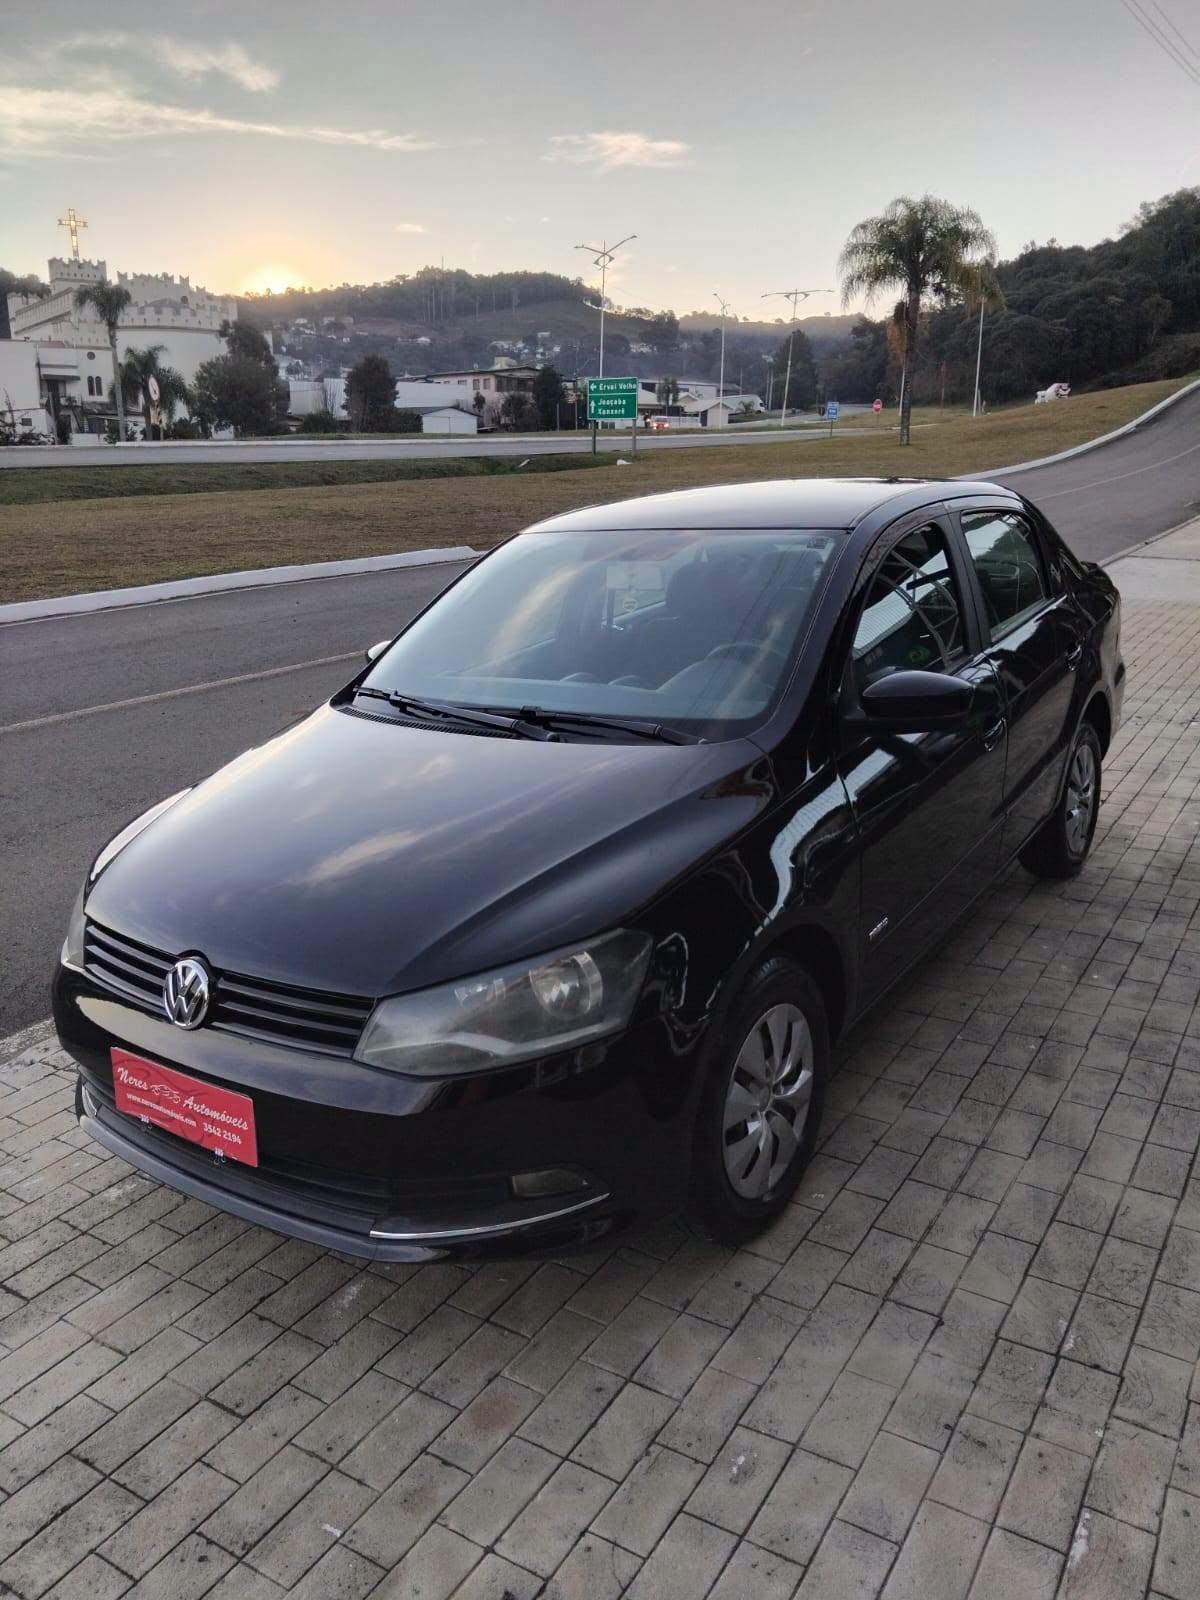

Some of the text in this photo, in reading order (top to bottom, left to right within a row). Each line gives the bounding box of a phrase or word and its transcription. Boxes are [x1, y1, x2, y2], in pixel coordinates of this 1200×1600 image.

[599, 383, 617, 391] Erval
[598, 399, 626, 407] Joaçaba
[165, 960, 209, 1029] VW
[117, 1067, 249, 1130] Neres Automóveis
[202, 1122, 242, 1145] 3542 2194
